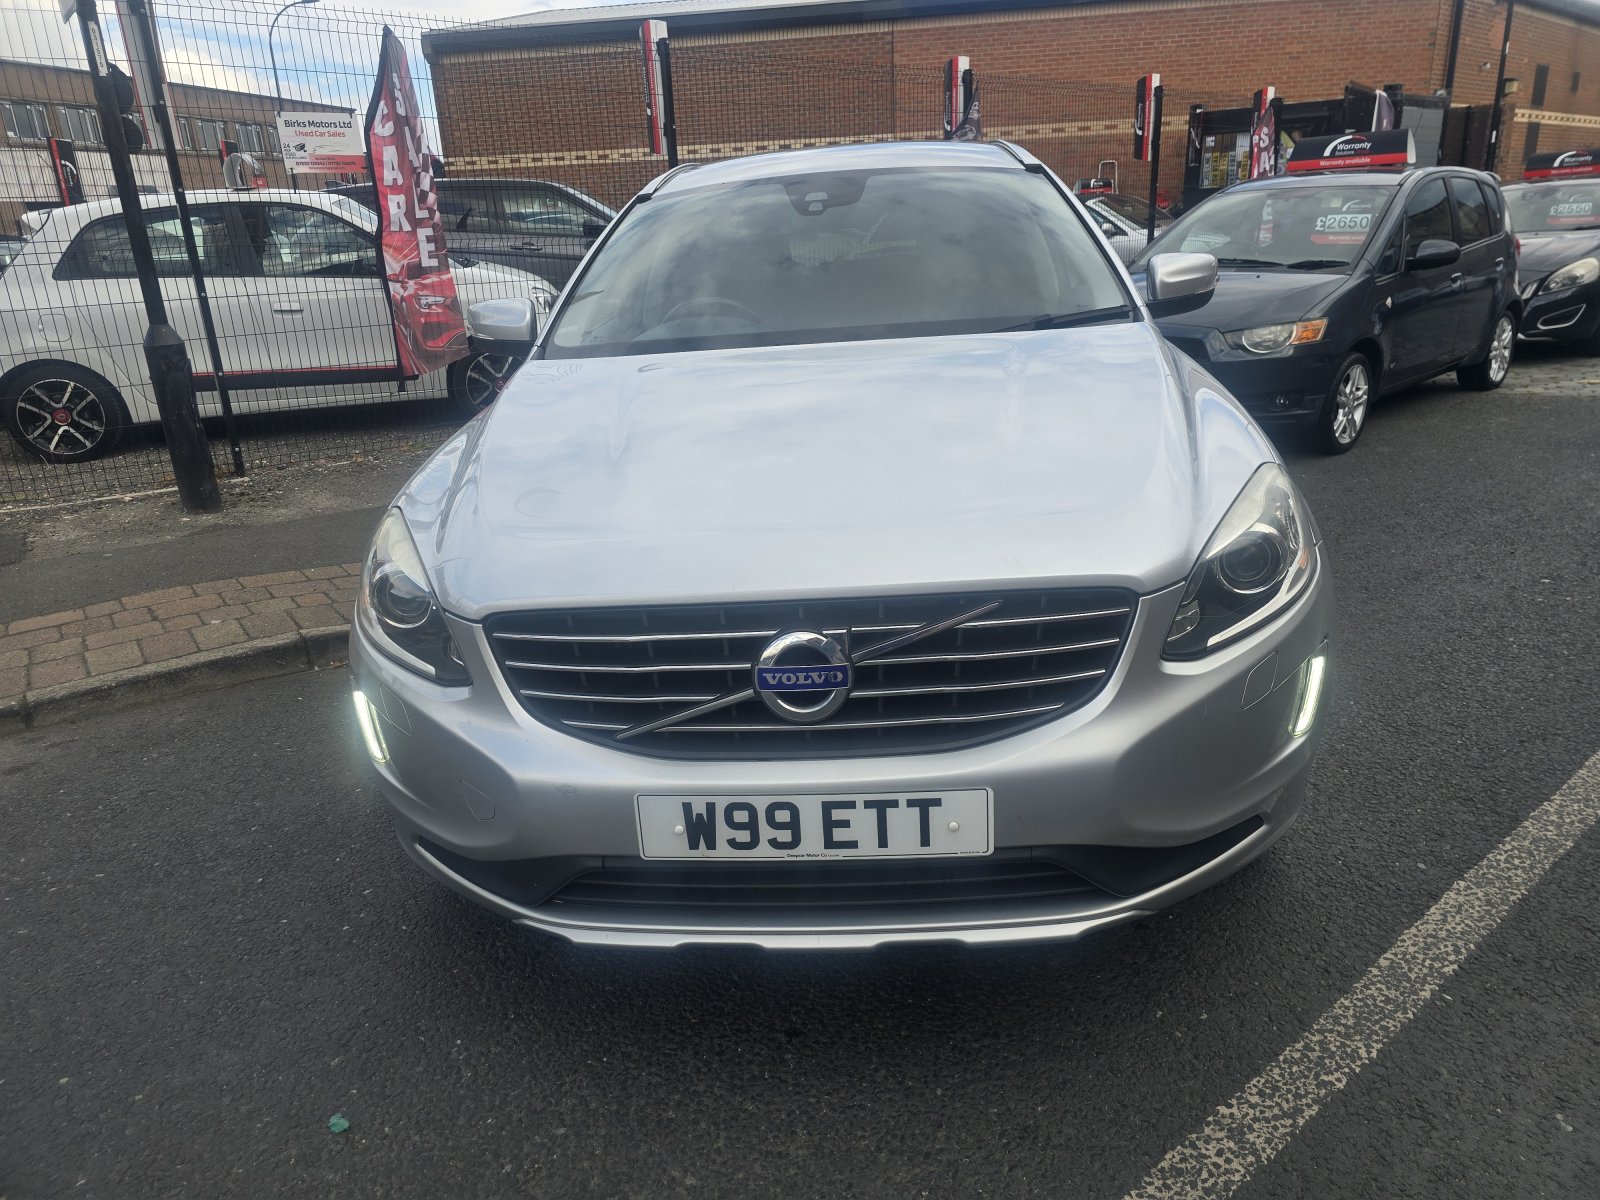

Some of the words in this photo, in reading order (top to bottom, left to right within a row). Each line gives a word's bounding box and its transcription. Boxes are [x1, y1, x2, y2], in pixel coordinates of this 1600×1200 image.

[284, 119, 307, 128] Birks
[308, 120, 338, 128] Motors
[339, 120, 353, 129] Ltd
[314, 130, 327, 138] Car
[327, 130, 346, 138] Sales
[1336, 142, 1372, 151] Warranty
[374, 100, 412, 232] CAR
[1320, 159, 1345, 167] Warranty
[1315, 216, 1370, 231] £2650
[762, 671, 843, 685] VOLVO
[682, 801, 802, 851] W99
[821, 797, 942, 850] ETT
